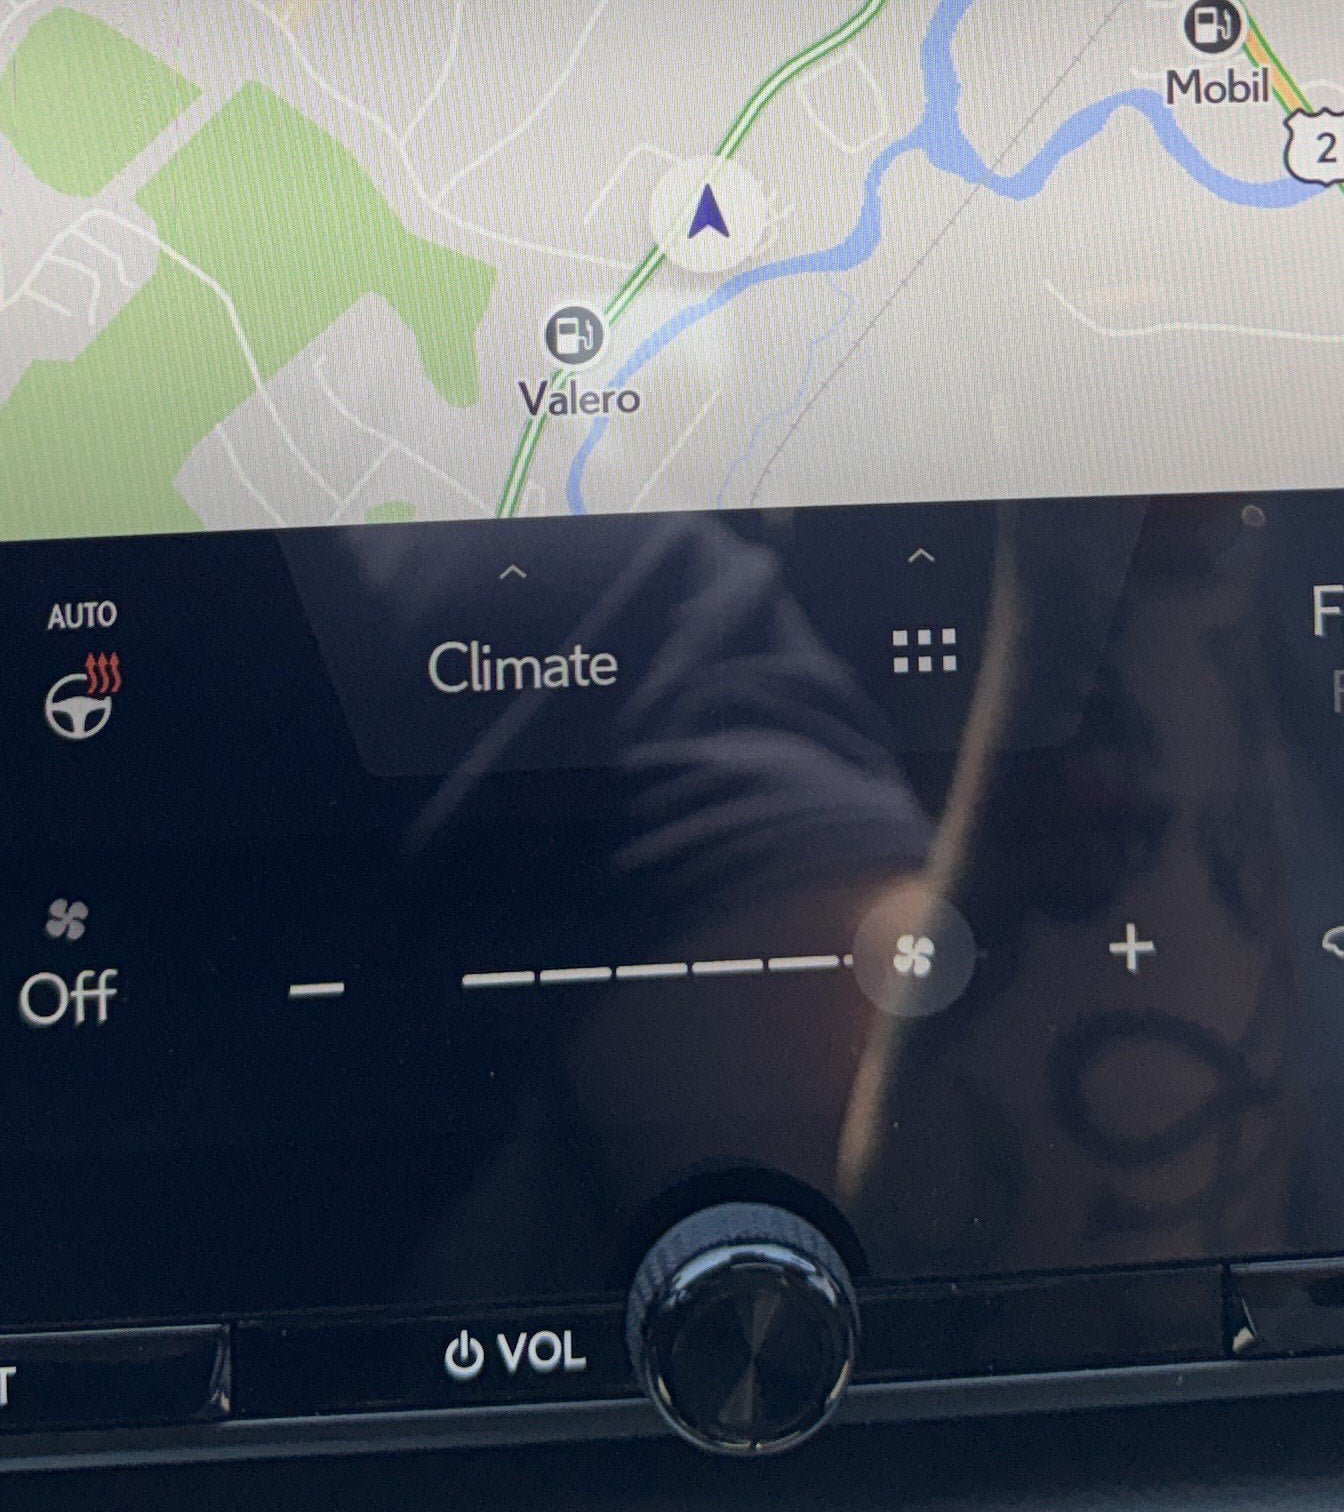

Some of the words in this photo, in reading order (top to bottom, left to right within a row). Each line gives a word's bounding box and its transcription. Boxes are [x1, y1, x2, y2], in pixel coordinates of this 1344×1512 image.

[1167, 69, 1270, 105] Mobil
[1317, 131, 1338, 164] 2
[519, 380, 641, 416] Valero
[47, 600, 118, 630] AUTO
[427, 640, 619, 694] Climate
[19, 968, 119, 1028] Off
[497, 1330, 587, 1373] VOL
